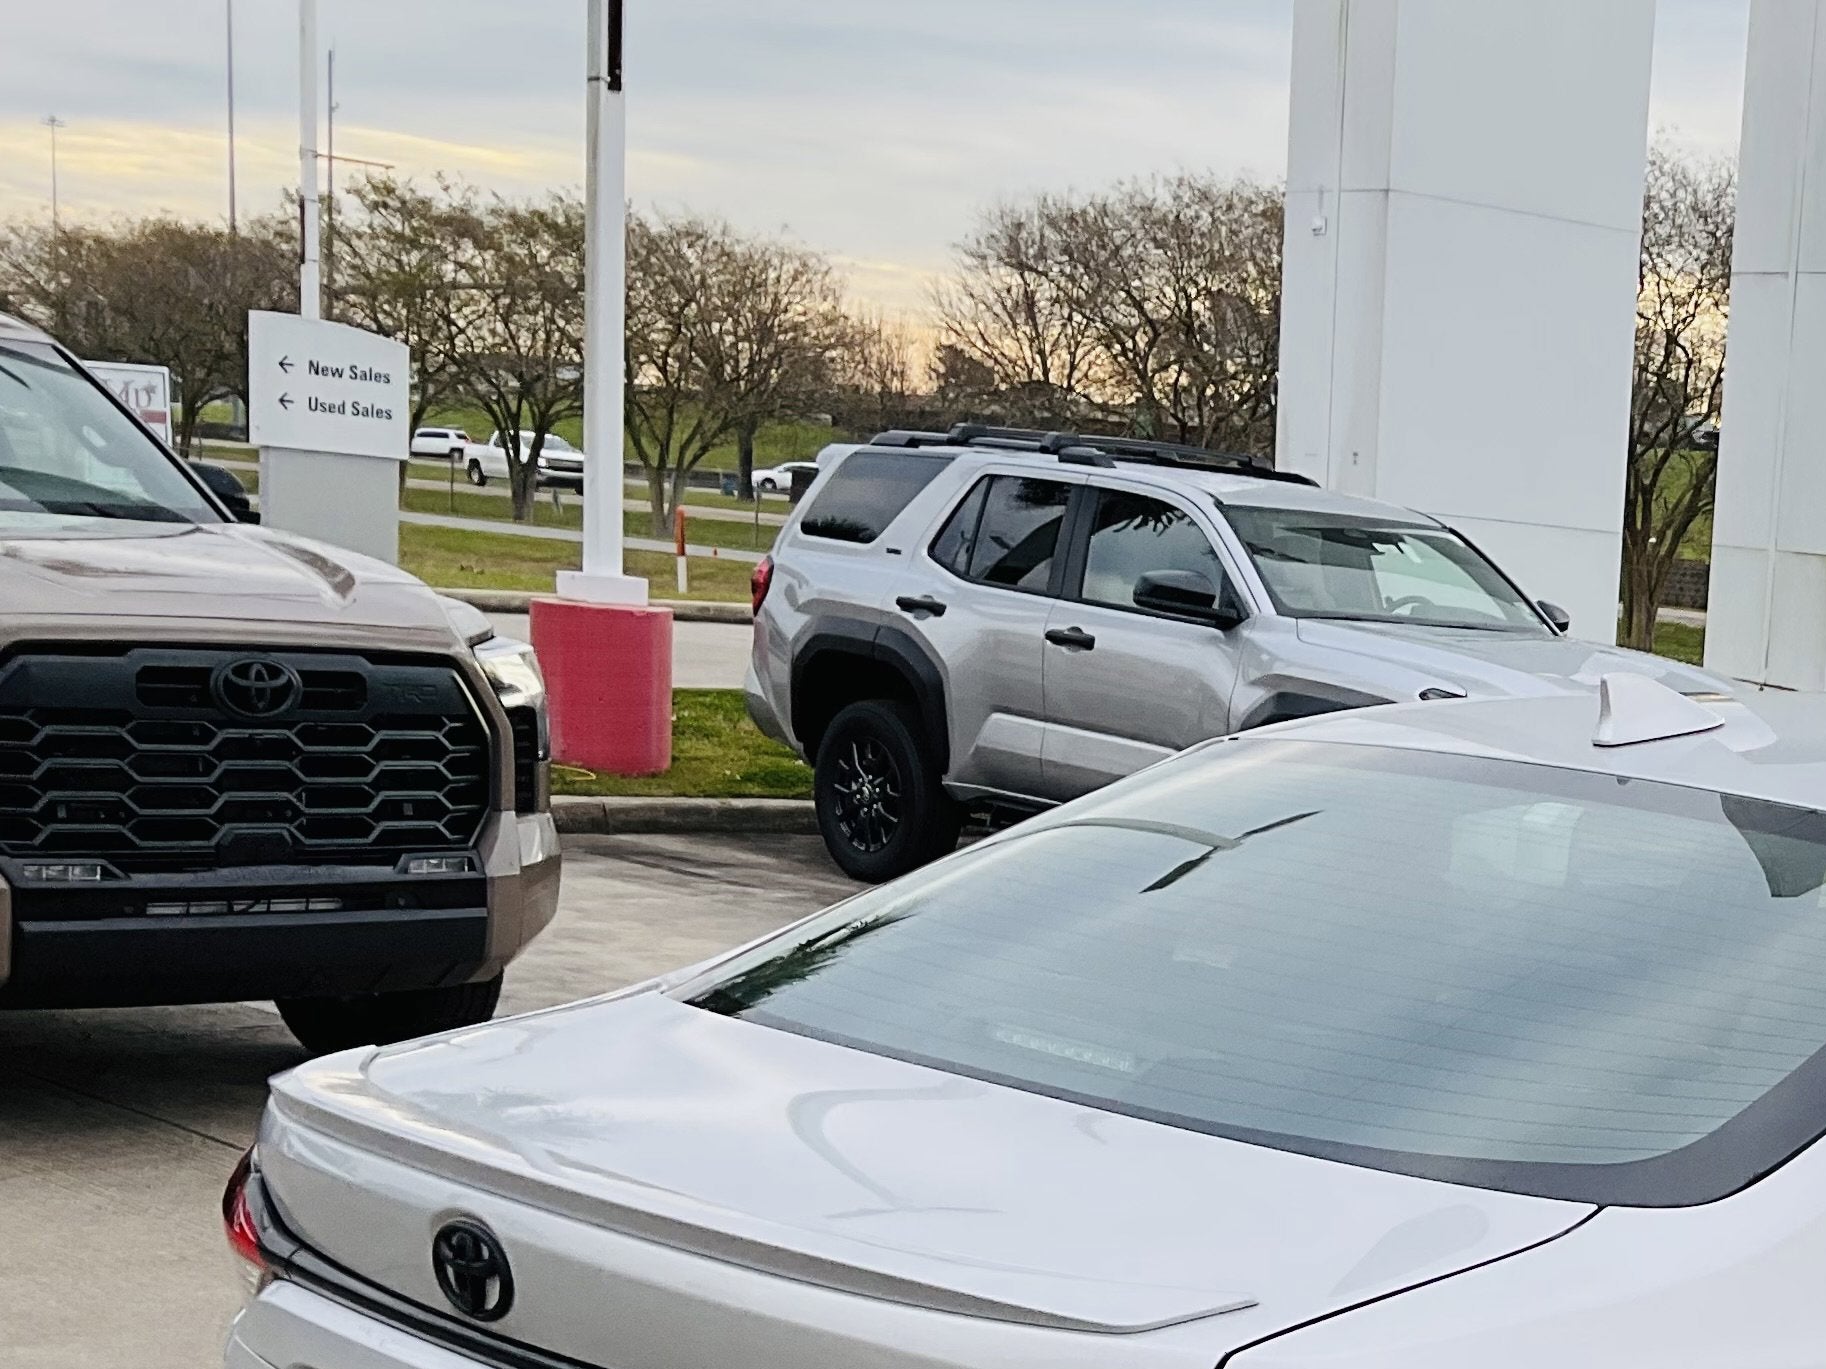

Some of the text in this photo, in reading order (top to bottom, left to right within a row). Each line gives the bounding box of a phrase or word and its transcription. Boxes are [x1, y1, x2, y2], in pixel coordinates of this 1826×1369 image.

[308, 359, 391, 384] New Sales
[308, 396, 393, 420] Used Sales
